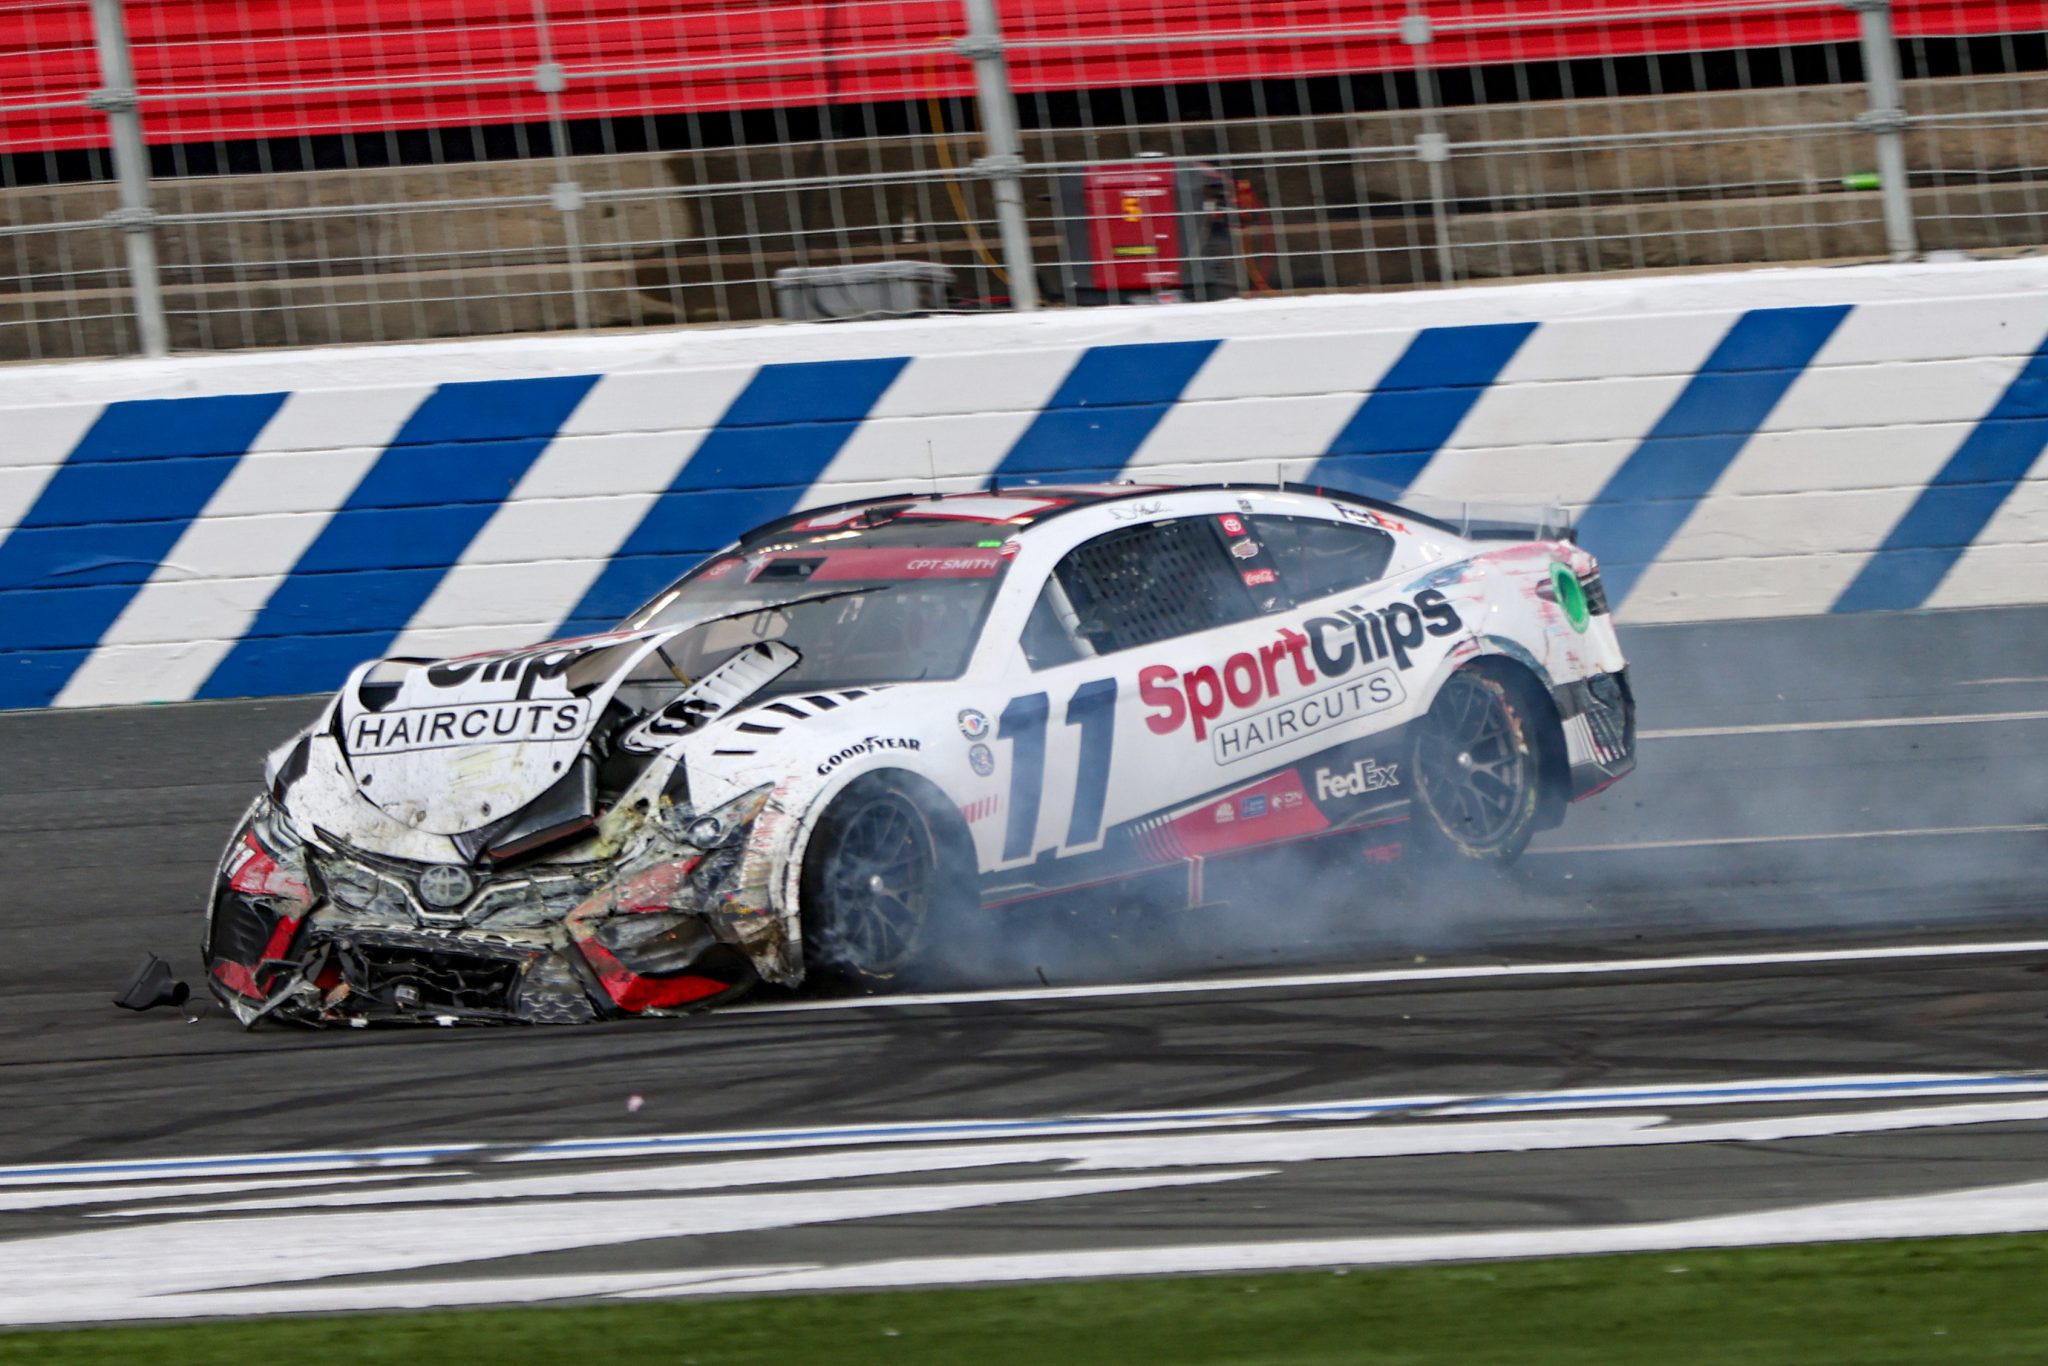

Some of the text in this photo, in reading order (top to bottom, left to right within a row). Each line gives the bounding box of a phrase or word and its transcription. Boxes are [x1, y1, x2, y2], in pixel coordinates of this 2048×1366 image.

[907, 559, 998, 570] CPT SMITH
[355, 703, 580, 750] HAIRCUTS
[1220, 676, 1393, 758] HAIRCUTS
[816, 736, 921, 776] GOODYEAR
[997, 677, 1118, 863] 11
[1315, 759, 1400, 801] FedEx
